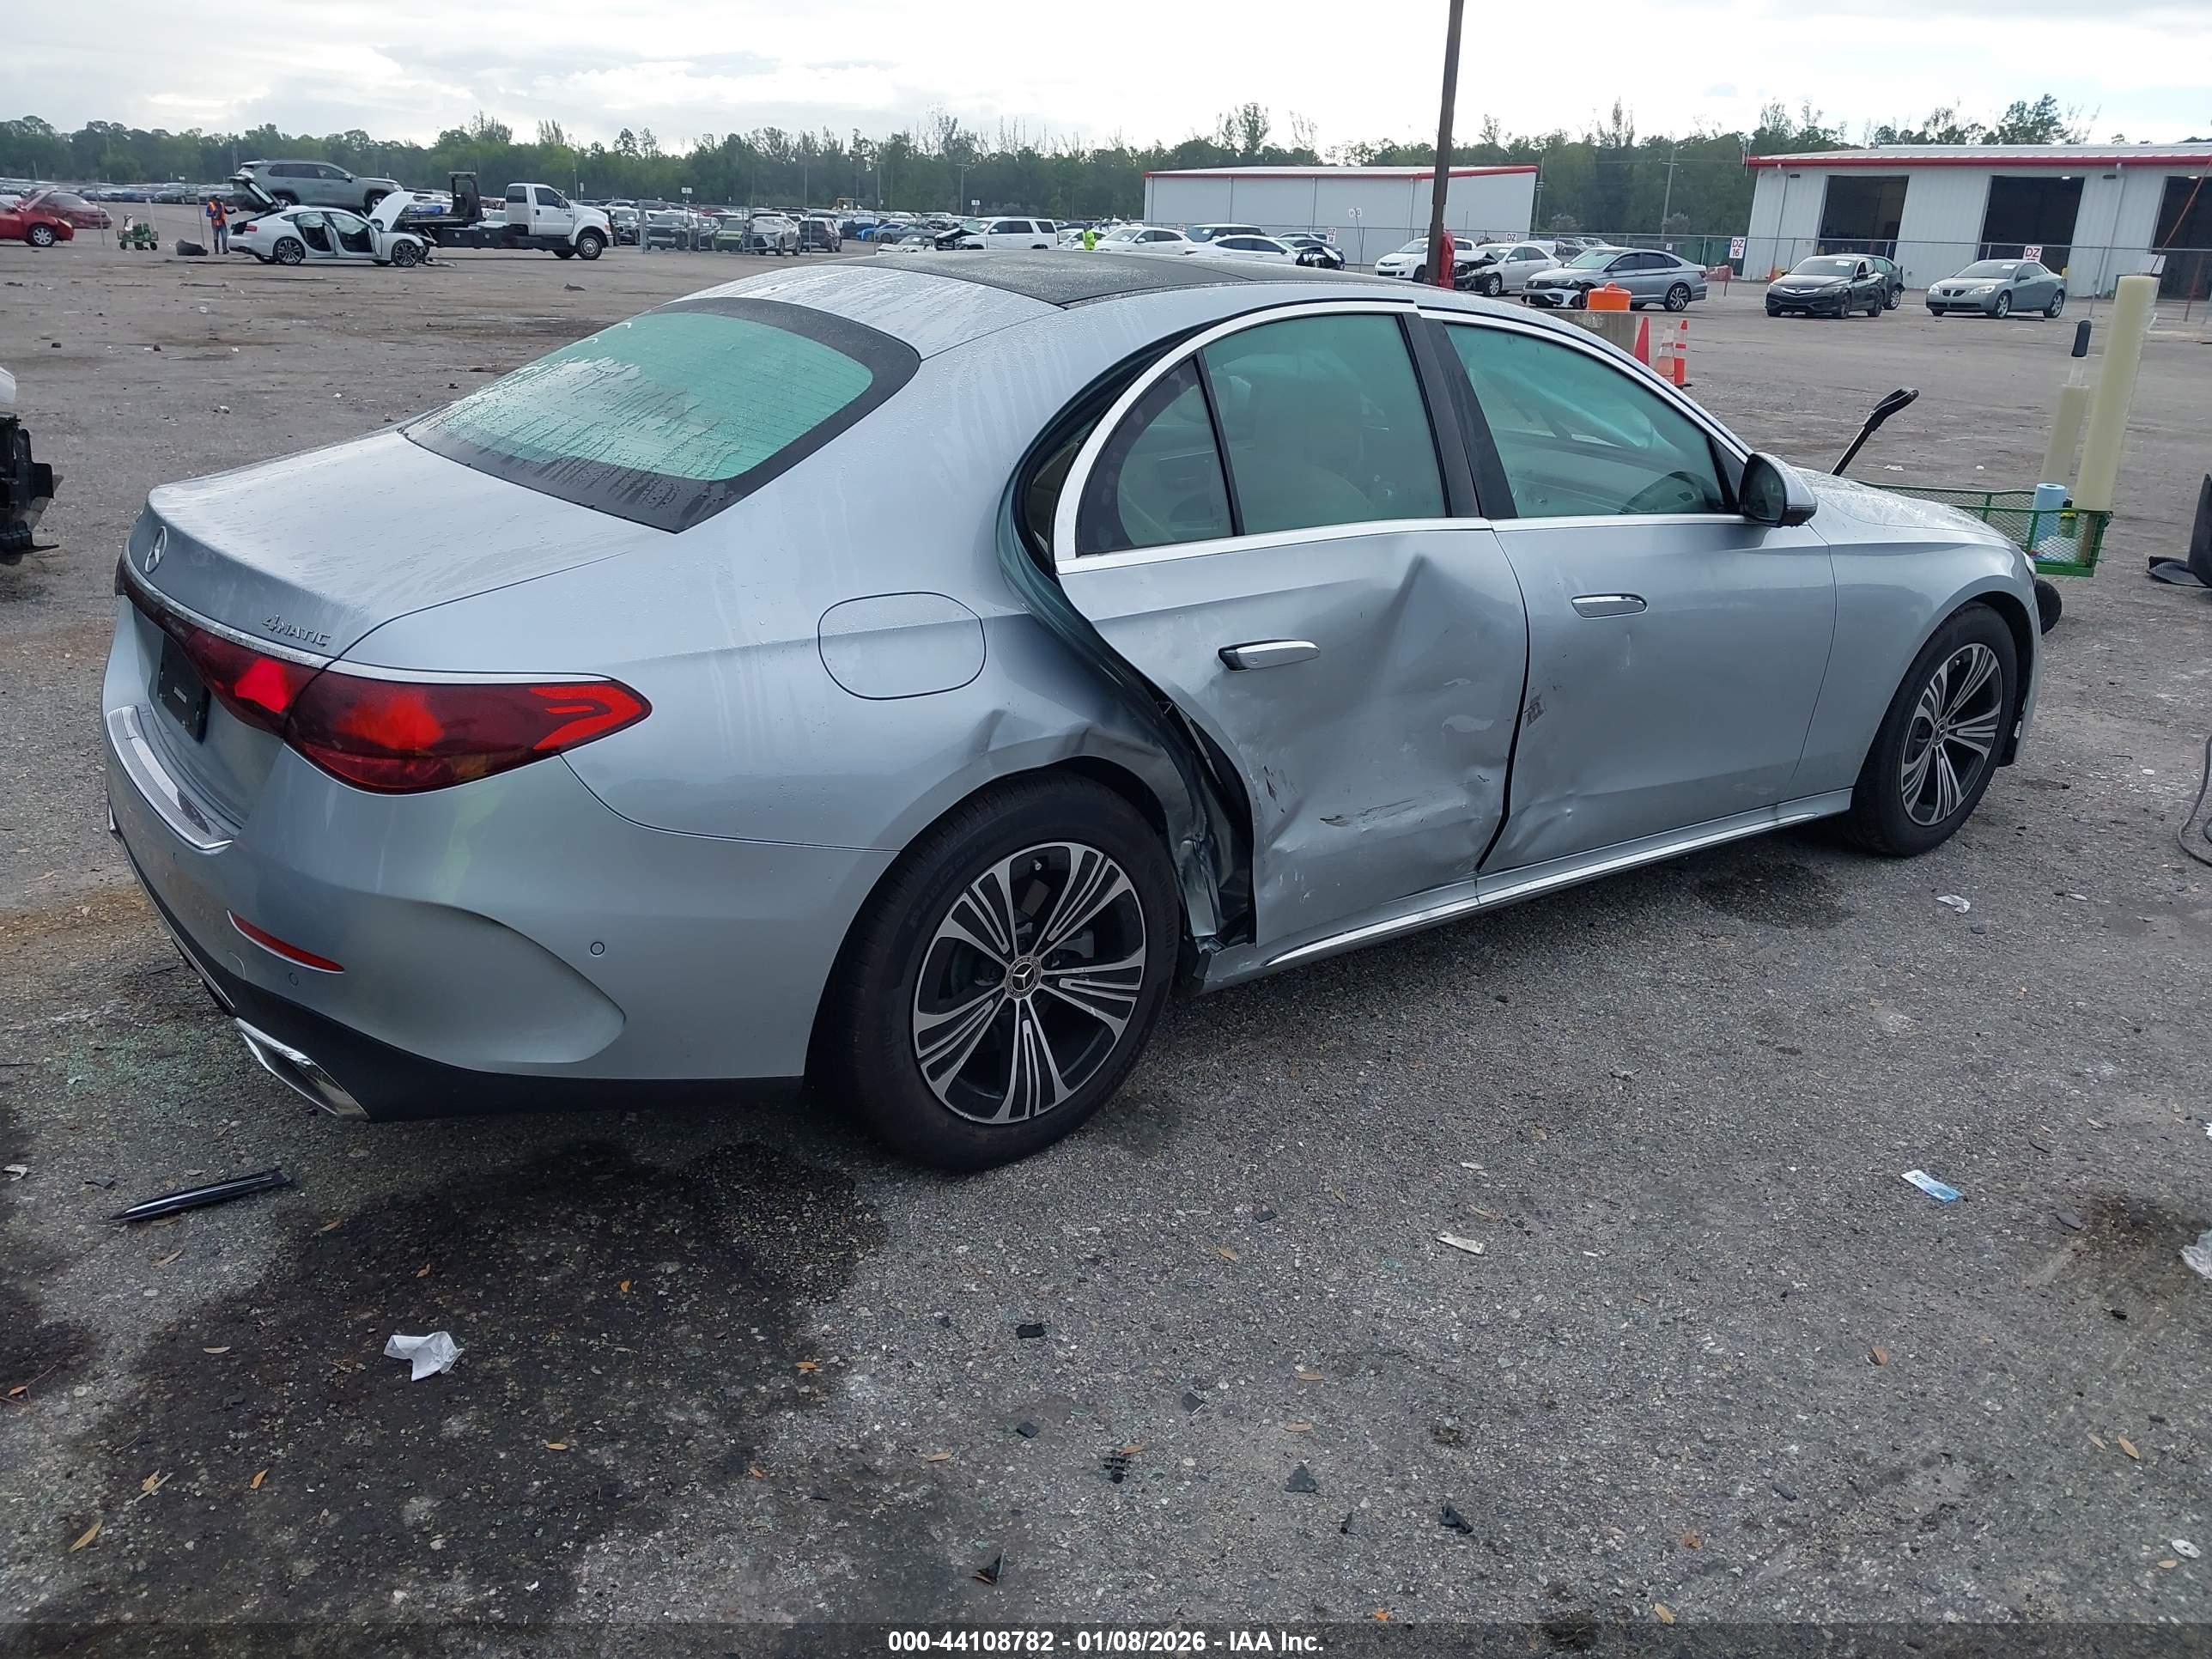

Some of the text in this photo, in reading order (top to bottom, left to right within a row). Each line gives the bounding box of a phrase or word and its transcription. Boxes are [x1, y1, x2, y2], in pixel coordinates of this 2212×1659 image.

[1507, 233, 1516, 241] DZ
[1732, 239, 1745, 248] DZ
[1732, 248, 1741, 257] 16
[2026, 247, 2041, 258] DZ
[261, 615, 331, 647] 4MATIC
